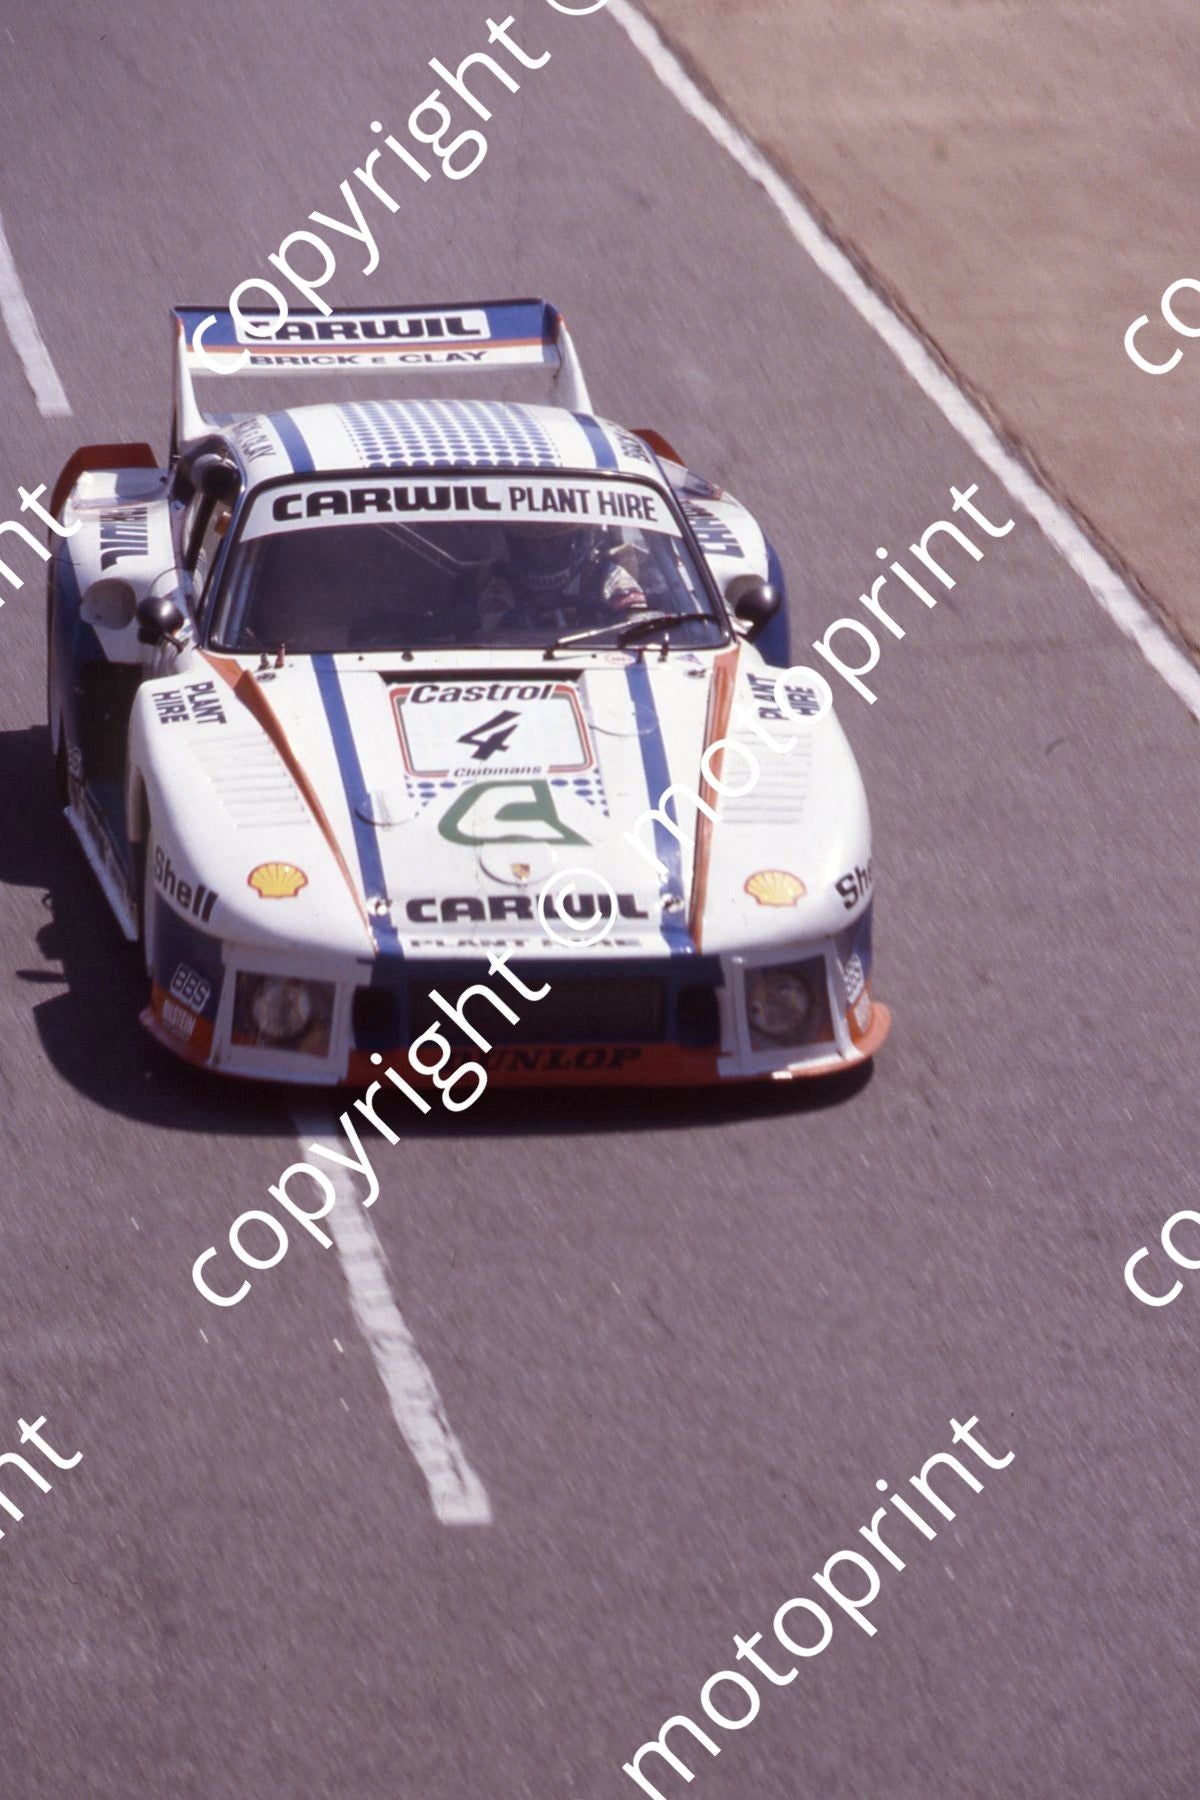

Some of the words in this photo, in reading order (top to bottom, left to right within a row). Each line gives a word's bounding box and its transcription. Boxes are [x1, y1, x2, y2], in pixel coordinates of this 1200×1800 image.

[249, 355, 358, 366] BRICK
[399, 350, 488, 364] CLAY
[272, 486, 501, 521] CARWIL
[509, 487, 591, 514] PLANT
[599, 491, 658, 523] HIRE
[152, 689, 190, 725] HIRE
[184, 680, 227, 725] PLANT
[409, 683, 555, 705] Castrol
[456, 709, 523, 761] 4
[453, 766, 542, 778] Clubmans
[154, 846, 219, 922] Shell
[406, 893, 649, 923] CARWIL
[172, 964, 211, 1007] BBS
